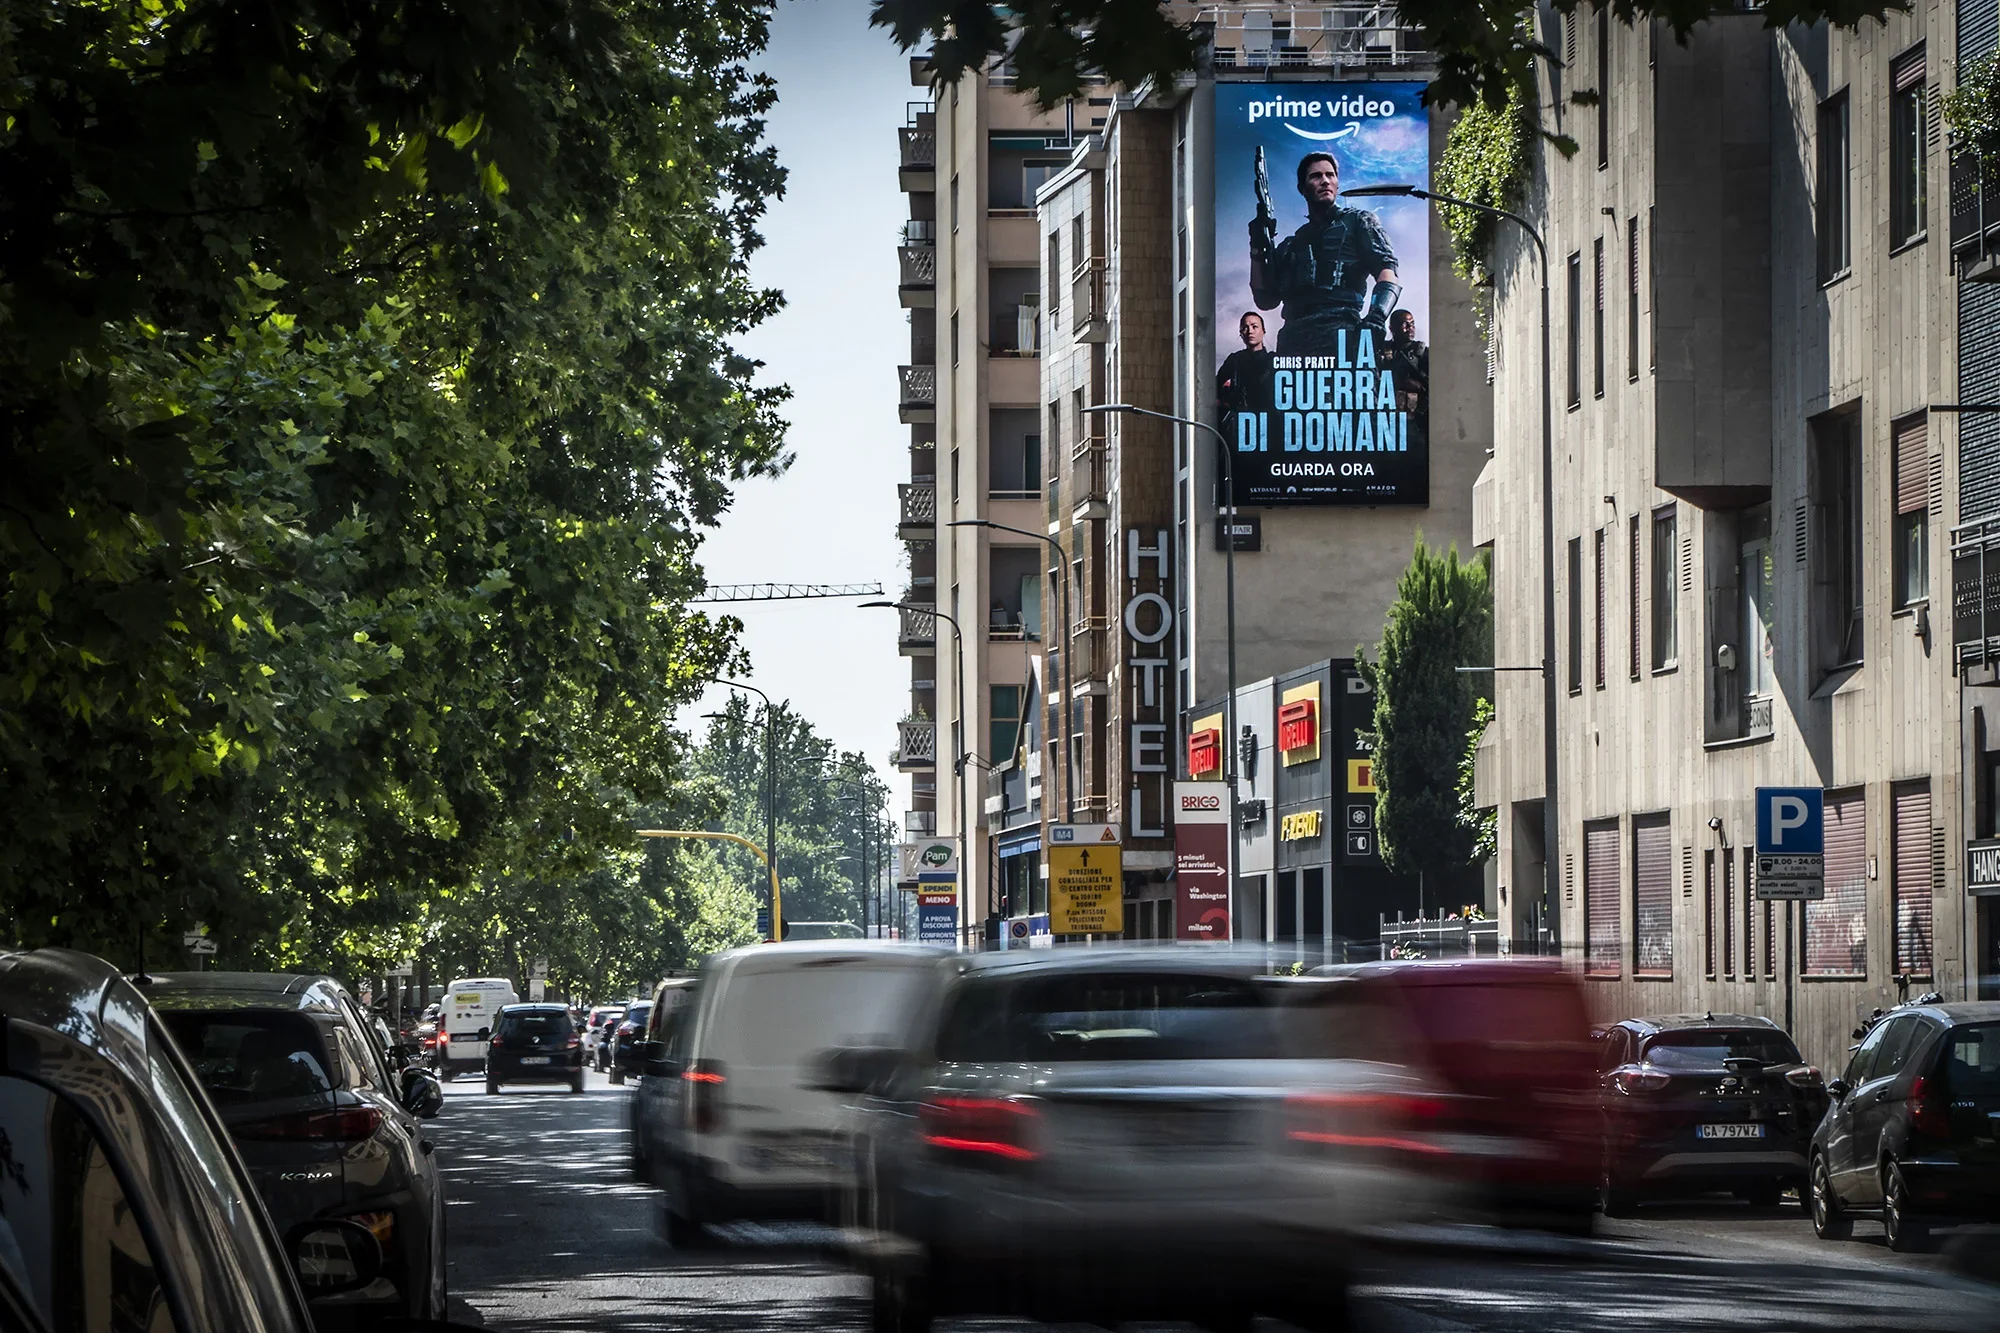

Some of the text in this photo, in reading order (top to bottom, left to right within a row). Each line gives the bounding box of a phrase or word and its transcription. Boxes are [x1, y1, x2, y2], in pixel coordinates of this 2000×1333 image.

[1249, 95, 1395, 123] prime video
[1338, 328, 1376, 369] LA
[1273, 356, 1336, 369] CHRIS PRATT
[1274, 370, 1397, 411] GUERRA
[1238, 412, 1408, 452] DI DOMANI
[1270, 463, 1375, 476] GUARDA ORA
[1125, 529, 1172, 837] HOTEL
[1182, 796, 1220, 808] BRICO
[1771, 796, 1808, 845] P
[926, 851, 948, 860] Pam
[1058, 876, 1099, 884] CONSIGLIATA
[1703, 1125, 1758, 1137] GA 797WZ
[280, 1172, 333, 1181] KONA
